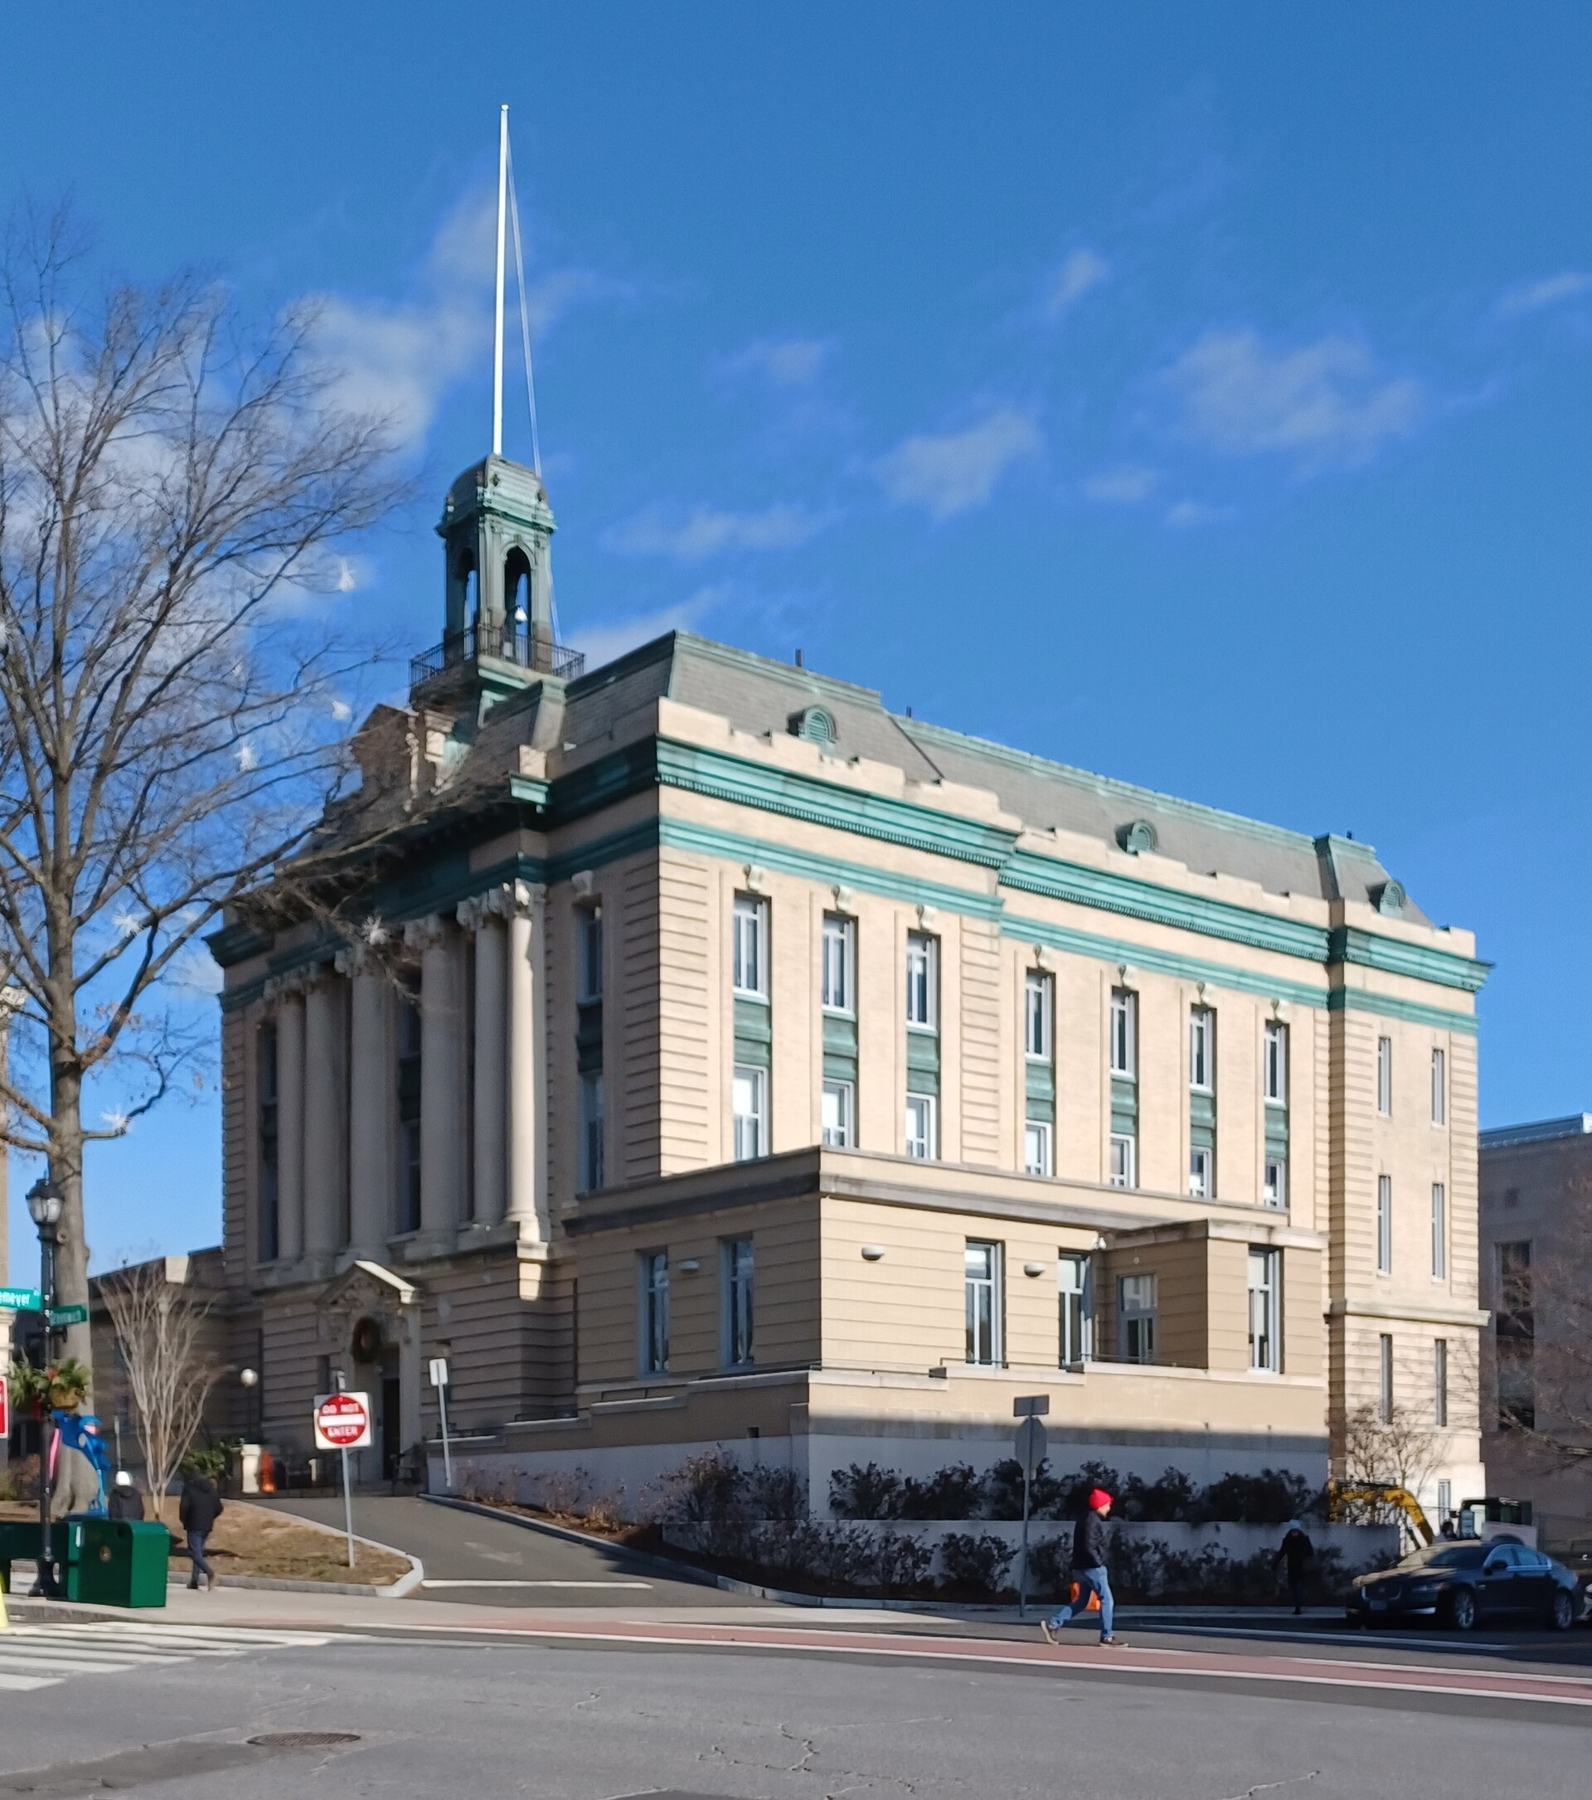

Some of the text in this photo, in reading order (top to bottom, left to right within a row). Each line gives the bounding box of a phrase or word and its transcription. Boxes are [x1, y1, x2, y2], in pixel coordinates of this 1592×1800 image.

[322, 1403, 359, 1415] DO NOT
[327, 1426, 358, 1437] ENTER
